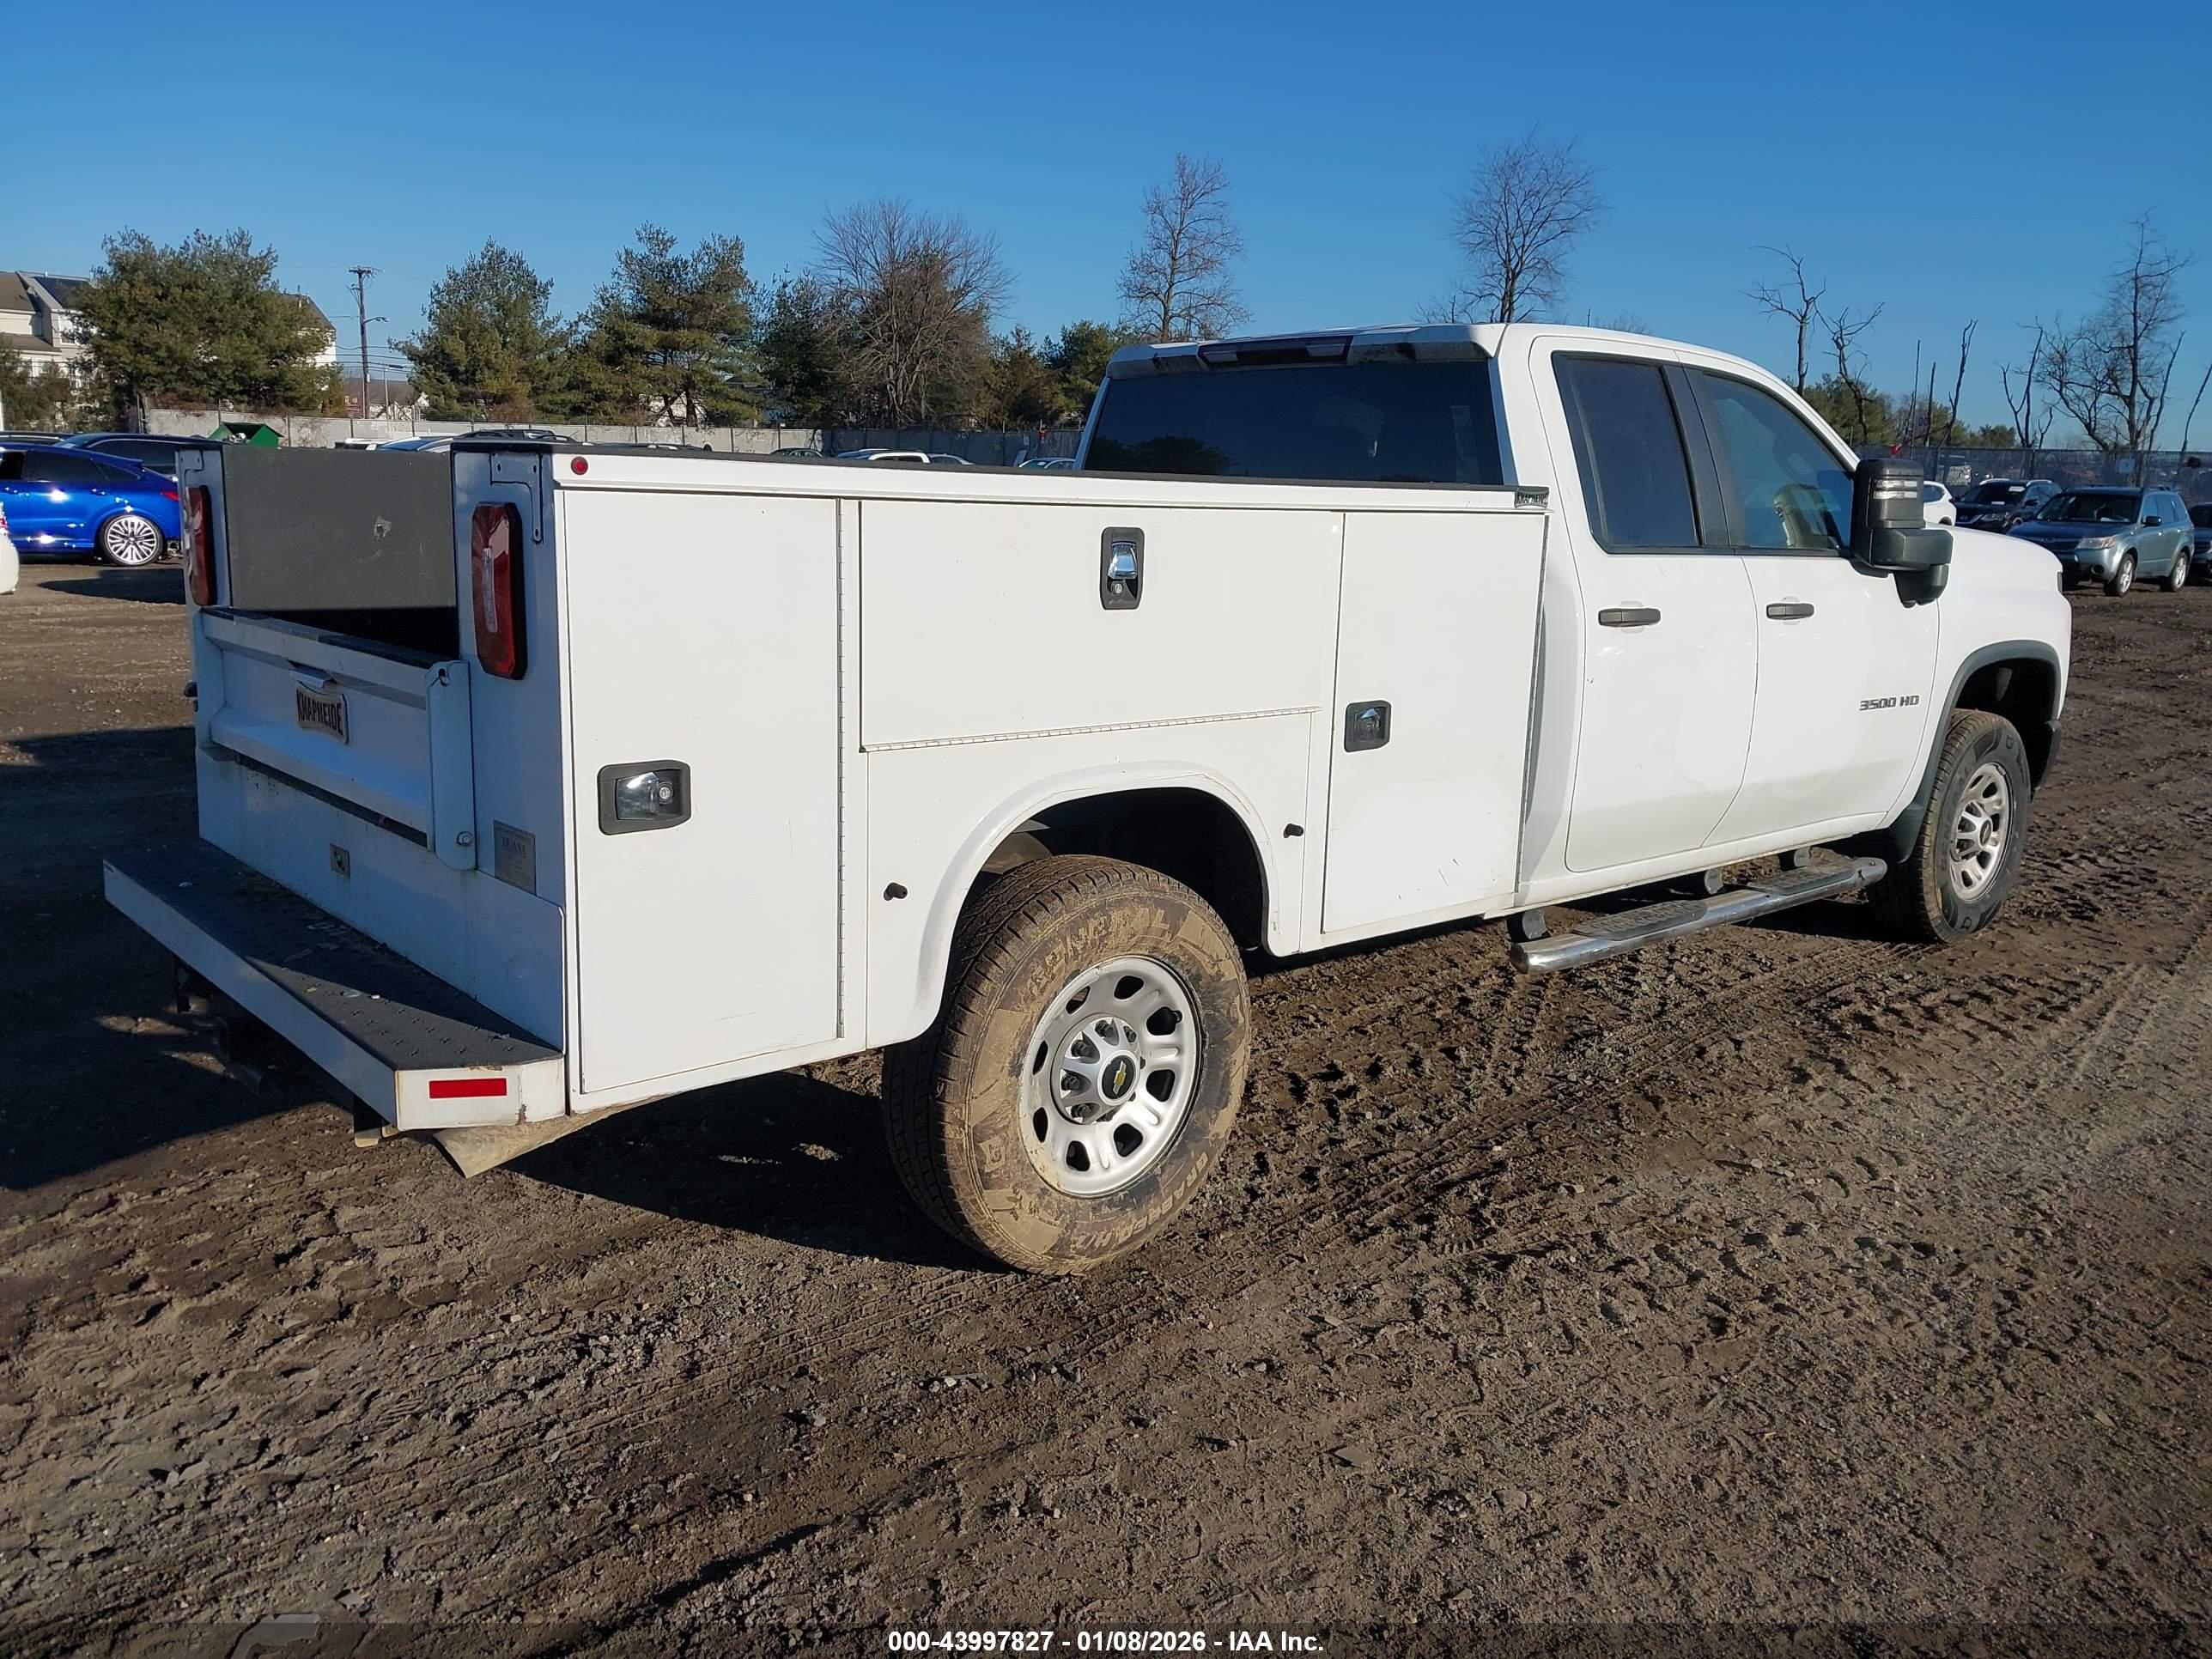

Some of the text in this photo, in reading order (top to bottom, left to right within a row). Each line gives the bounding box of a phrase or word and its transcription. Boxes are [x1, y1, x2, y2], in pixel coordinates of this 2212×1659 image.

[296, 689, 343, 736] KNAPHEIDE
[1859, 695, 1920, 711] 3500 HD
